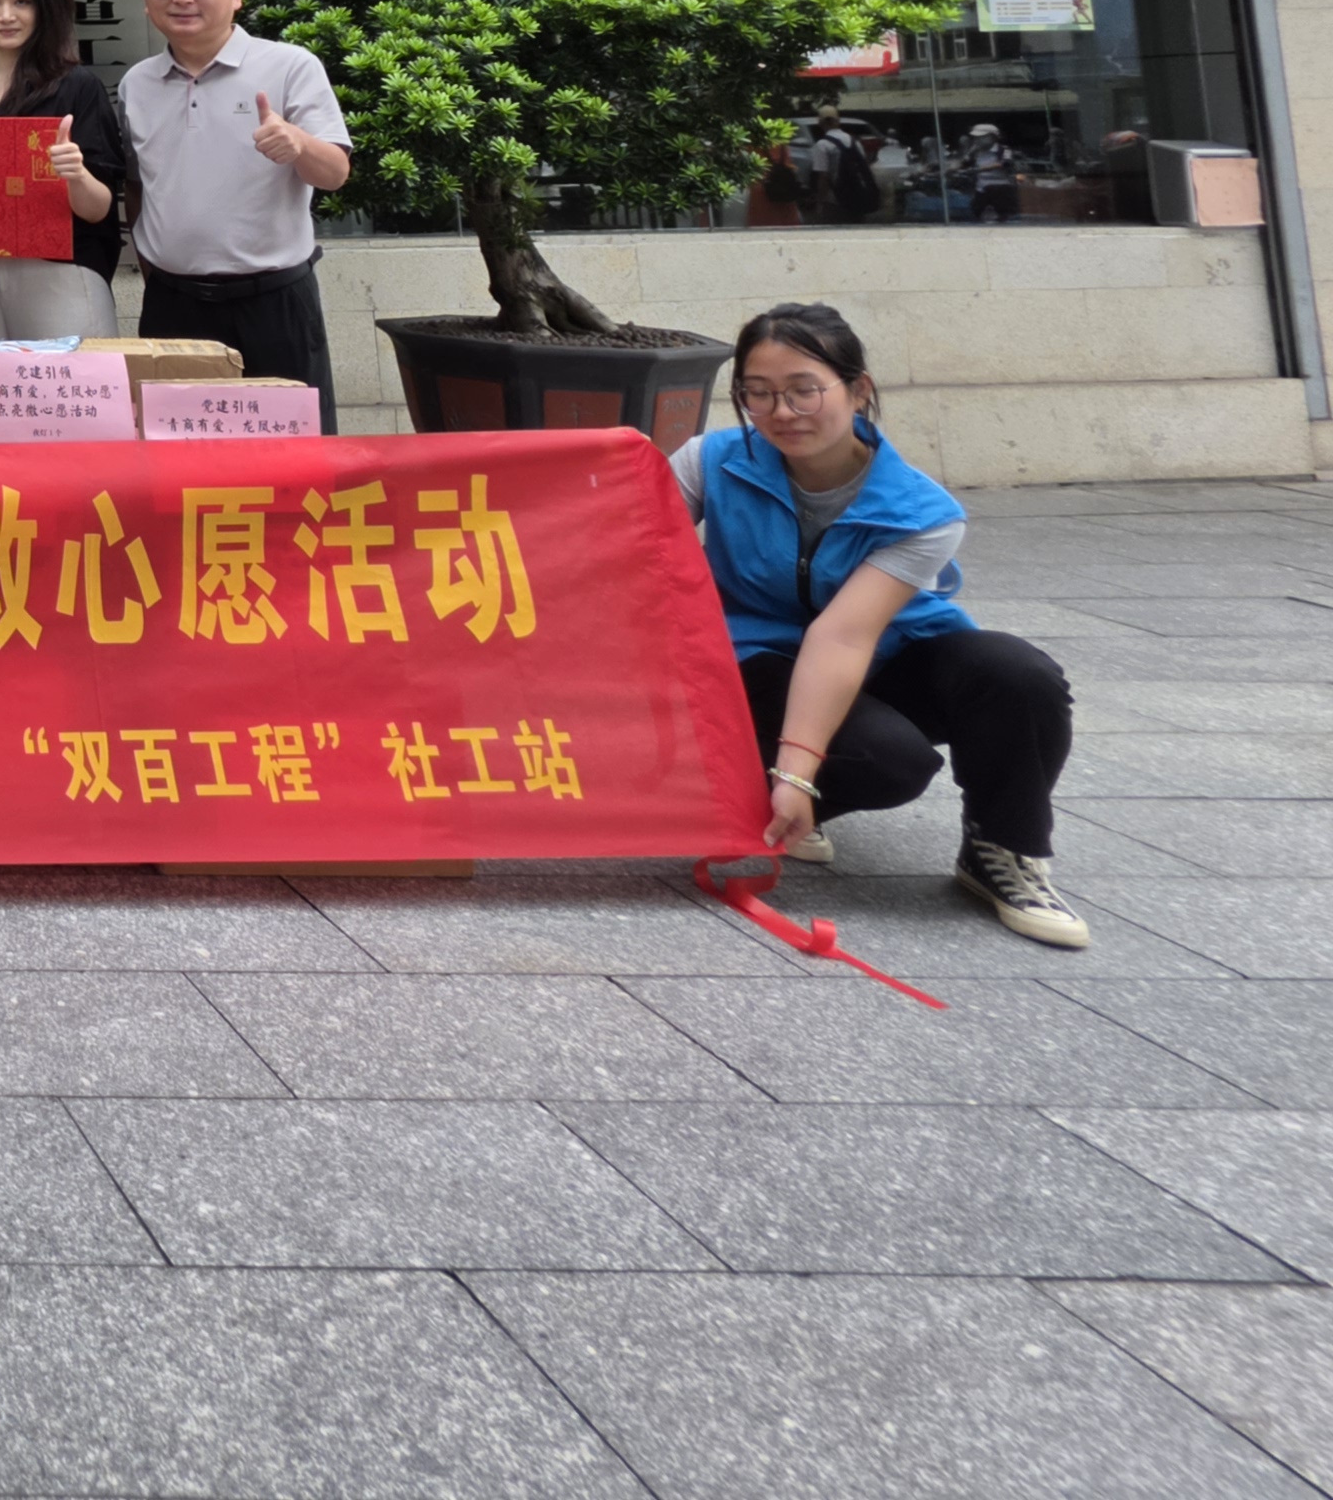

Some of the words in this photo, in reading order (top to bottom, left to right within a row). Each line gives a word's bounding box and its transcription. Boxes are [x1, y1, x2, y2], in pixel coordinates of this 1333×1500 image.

[15, 365, 73, 380] 党建引领
[201, 399, 260, 414] 党建引领
[22, 721, 343, 805] “双百工程”
[381, 718, 585, 802] 社工站
